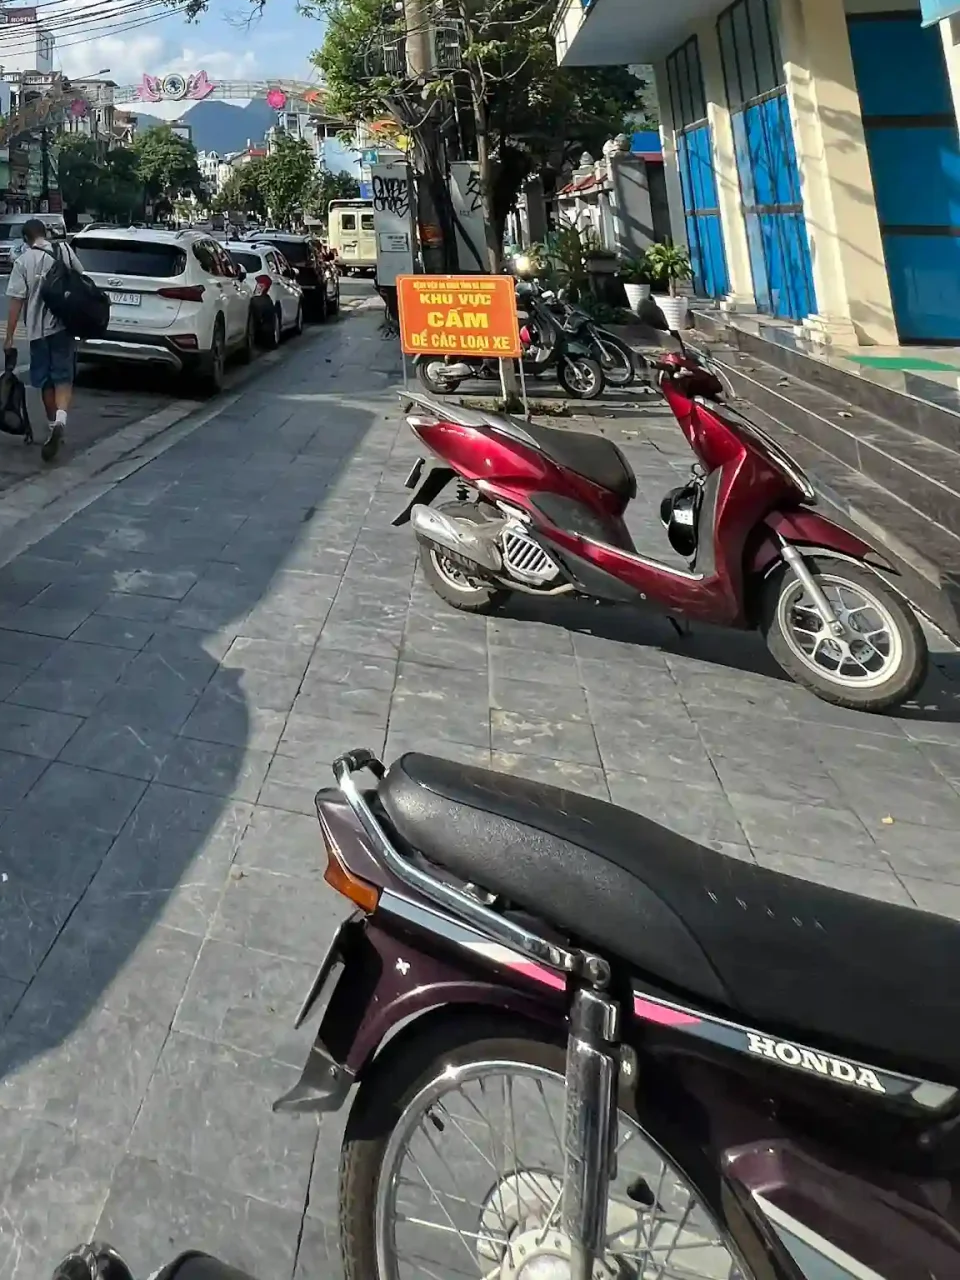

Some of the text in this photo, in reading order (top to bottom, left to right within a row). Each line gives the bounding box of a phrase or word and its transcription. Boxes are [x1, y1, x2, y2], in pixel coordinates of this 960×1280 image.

[419, 293, 492, 307] KHU VỰC
[427, 306, 489, 328] CẤM
[431, 330, 456, 348] CÁC
[460, 334, 489, 351] LOẠI
[493, 336, 510, 349] XE
[746, 1032, 886, 1094] HONDA
